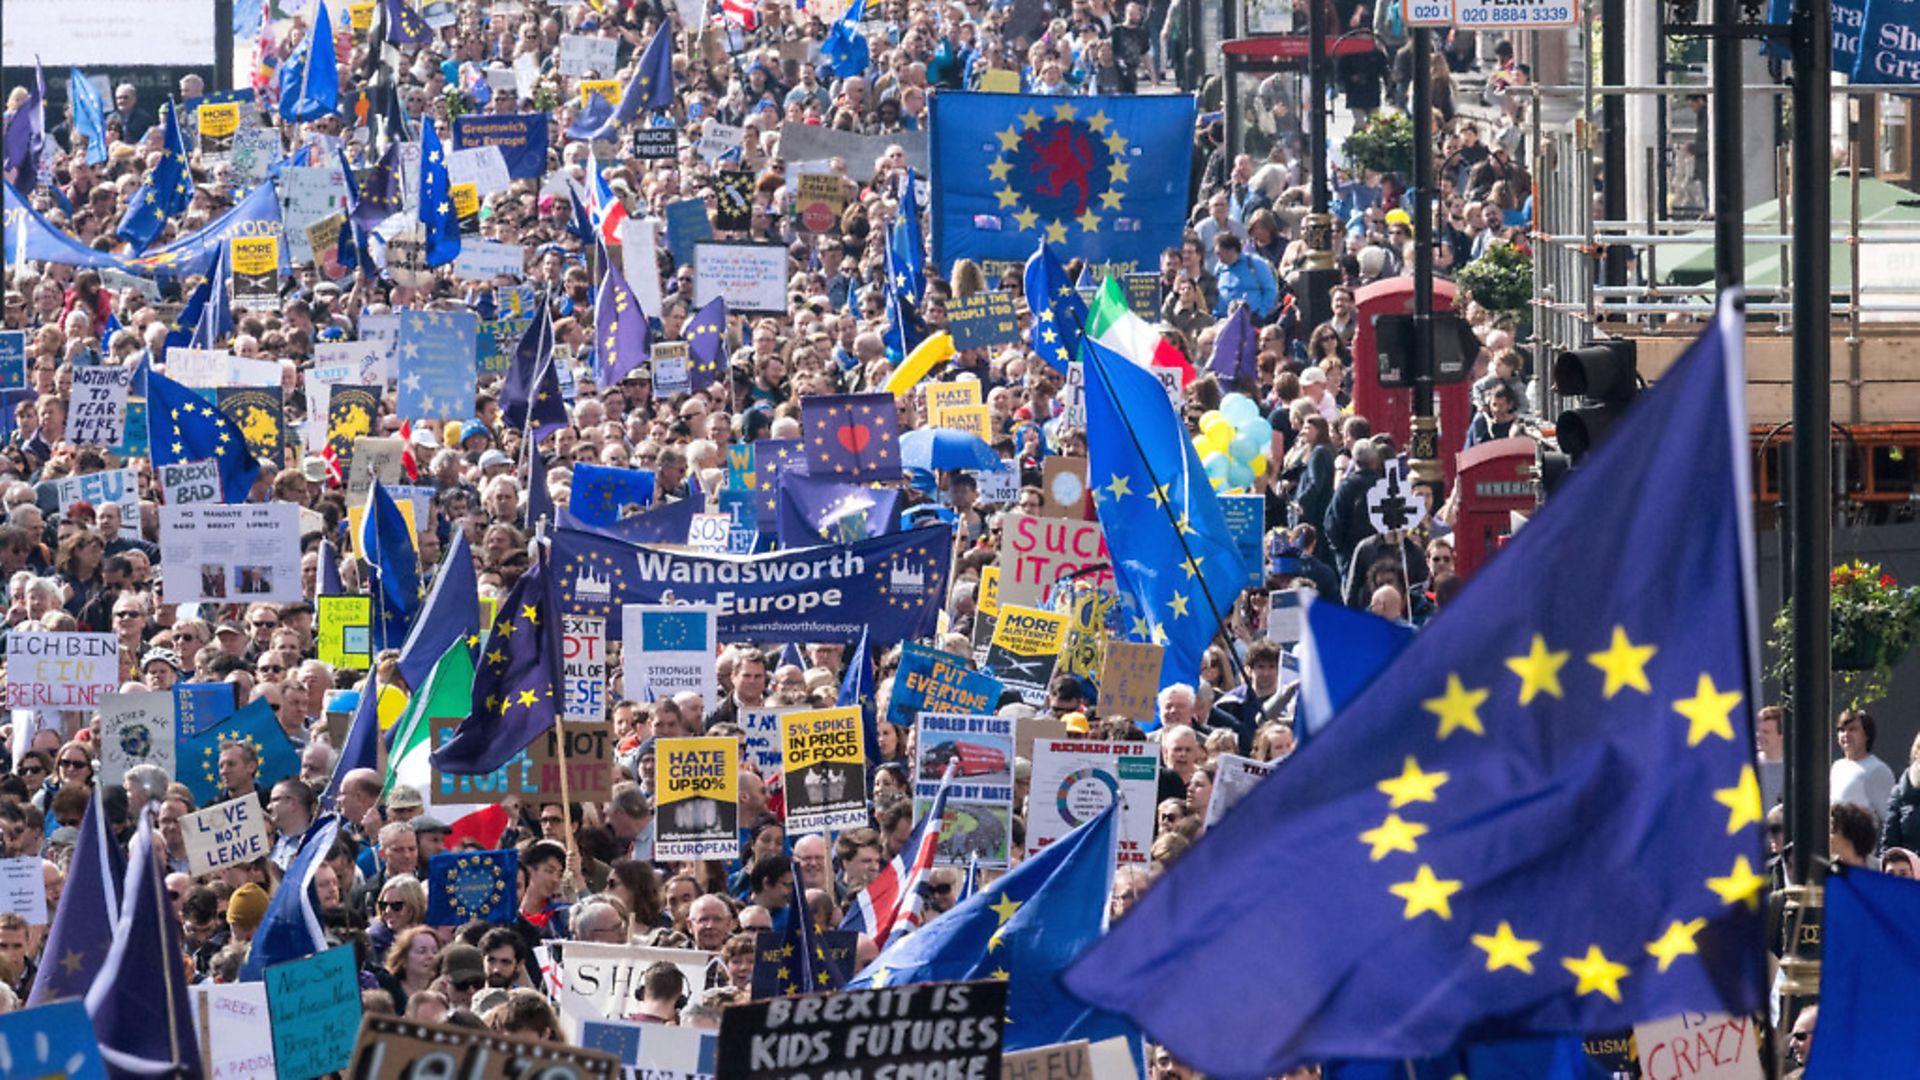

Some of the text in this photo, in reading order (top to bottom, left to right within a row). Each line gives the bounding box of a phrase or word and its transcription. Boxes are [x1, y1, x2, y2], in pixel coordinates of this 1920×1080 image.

[1414, 6, 1439, 17] 020
[1463, 7, 1569, 22] 020 8884 3339
[1875, 51, 1920, 80] Gra
[462, 123, 527, 134] Greenwich
[463, 136, 527, 147] for Europe
[236, 243, 272, 254] MORE
[946, 304, 1012, 321] PEOPLE TOO
[73, 368, 128, 387] NOTHING
[90, 388, 109, 400] TO
[936, 389, 972, 400] HATE
[78, 402, 117, 416] FEAR
[75, 418, 115, 430] HERE
[947, 413, 980, 424] HATE
[79, 472, 124, 506] EU
[177, 485, 215, 505] BAD
[180, 510, 194, 518] NO
[203, 510, 242, 518] MANDATE
[691, 517, 726, 541] SOS
[637, 550, 865, 585] Wandsworth
[1016, 556, 1050, 584] IT
[717, 587, 842, 616] Europe
[1006, 614, 1060, 633] MORE
[1001, 626, 1056, 640] AUSTERITY
[563, 635, 600, 661] OT
[37, 660, 95, 681] EIN
[648, 666, 702, 676] STRONGER
[932, 661, 968, 684] PUT
[648, 677, 702, 687] TOGETHER
[906, 672, 989, 711] EVERYONE
[747, 713, 777, 731] I AM
[789, 717, 856, 736] 5% SPIKE
[923, 716, 1011, 734] FOOLED BY LIES
[548, 731, 608, 759] NOT
[789, 731, 857, 749] IN PRICE
[1050, 741, 1110, 755] REMAIN
[669, 750, 725, 765] HATE
[789, 745, 858, 763] OF FOOD
[541, 763, 607, 793] HATE
[669, 764, 725, 779] CRIME
[692, 778, 726, 791] 50%
[916, 783, 963, 798] FUEED
[965, 785, 979, 799] BY
[801, 811, 867, 828] EUROPEAN
[214, 825, 242, 844] NOT
[207, 835, 261, 867] LEAVE
[671, 842, 737, 855] EUROPEAN
[214, 1000, 257, 1017] CREEK
[766, 984, 971, 1029] BREXIT IS
[750, 1016, 998, 1071] KIDS FUTURES
[1583, 1039, 1629, 1056] ALISM
[1647, 1018, 1748, 1080] CRAZY
